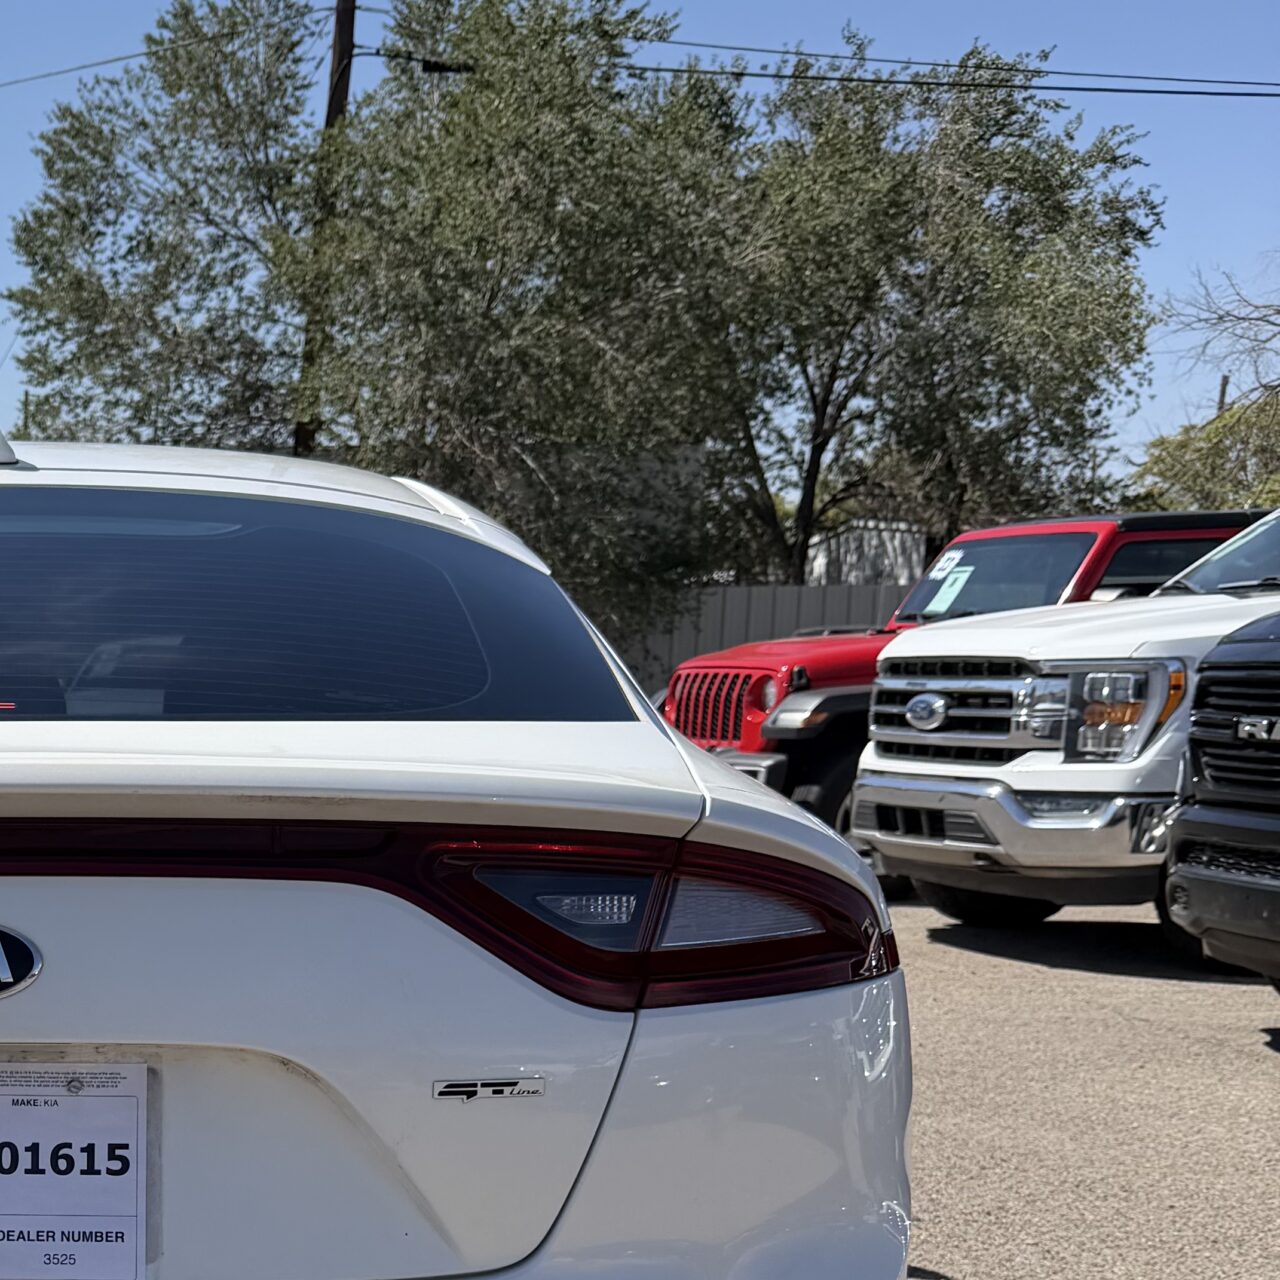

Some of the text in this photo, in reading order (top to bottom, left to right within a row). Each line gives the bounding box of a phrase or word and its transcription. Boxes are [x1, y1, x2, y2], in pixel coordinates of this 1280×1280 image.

[509, 1088, 542, 1096] Line
[60, 1231, 125, 1243] NUMBER
[43, 1253, 76, 1265] 3525
